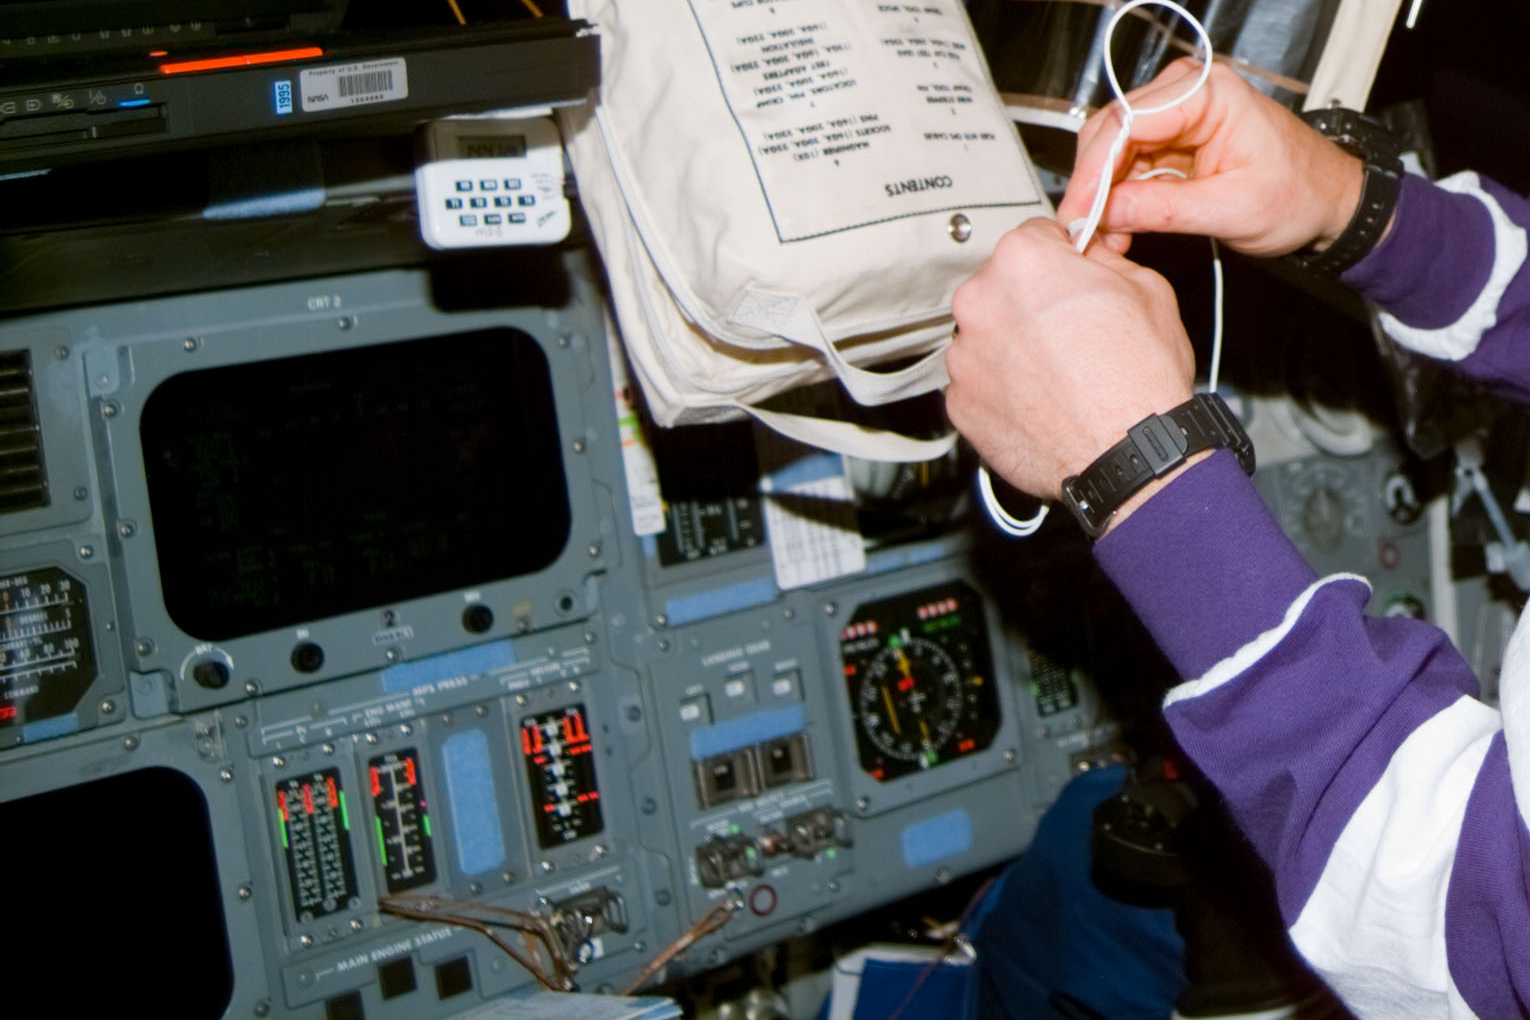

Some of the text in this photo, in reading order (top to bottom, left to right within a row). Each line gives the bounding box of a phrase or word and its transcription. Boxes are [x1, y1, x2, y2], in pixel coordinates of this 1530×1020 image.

[763, 66, 806, 80] ADAPTERS
[278, 83, 291, 109] 1995
[860, 114, 878, 123] PINS
[856, 124, 891, 137] SOCKETS
[823, 141, 869, 155] MAGNIFIER
[885, 175, 952, 198] CONTENTS
[337, 927, 452, 972] MAIN ENGINE STATUS
